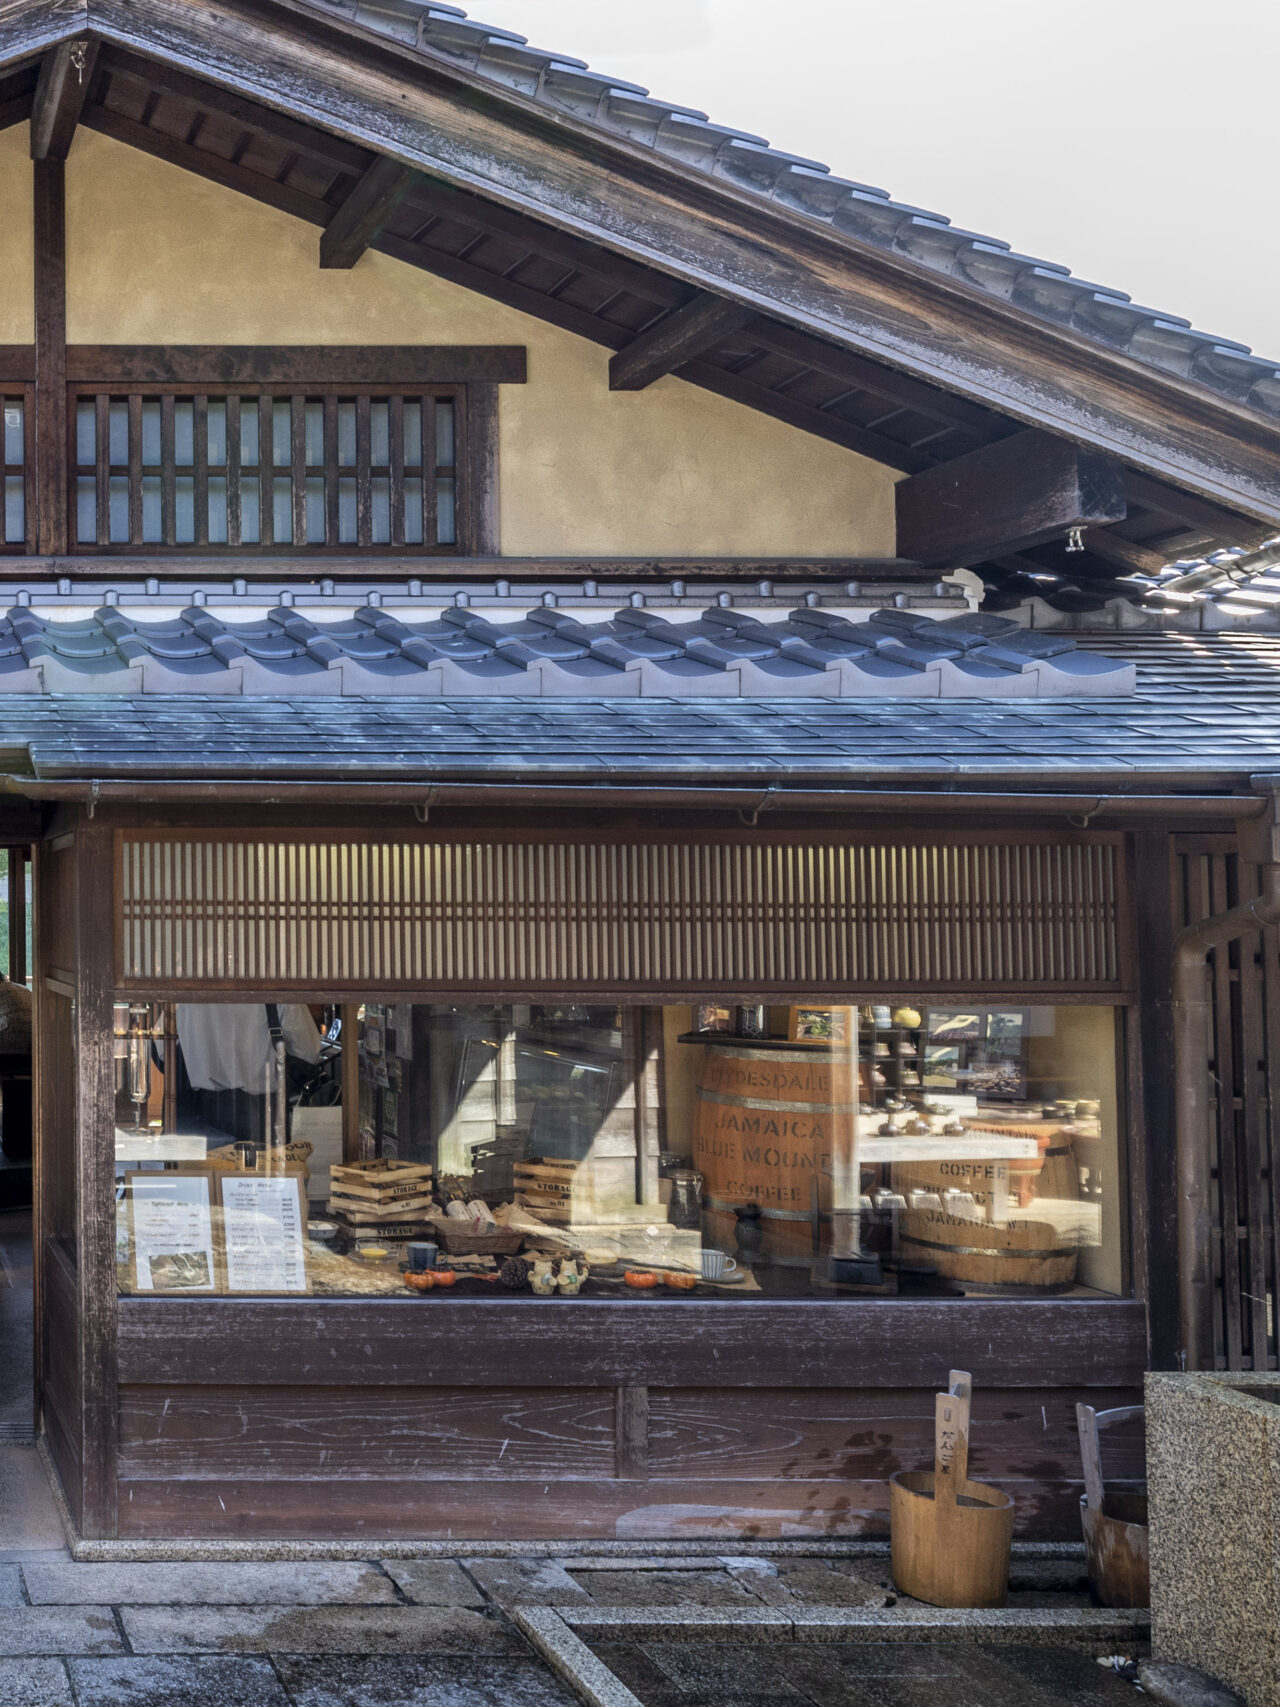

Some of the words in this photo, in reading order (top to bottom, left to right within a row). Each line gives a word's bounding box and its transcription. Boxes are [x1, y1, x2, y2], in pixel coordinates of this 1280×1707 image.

[714, 1113, 825, 1139] JAMAICA
[697, 1135, 735, 1160] BLUE
[939, 1162, 1008, 1180] COFFEE
[393, 1185, 418, 1195] STORAGE
[726, 1180, 801, 1201] COFFEE
[377, 1226, 413, 1236] STORAGE
